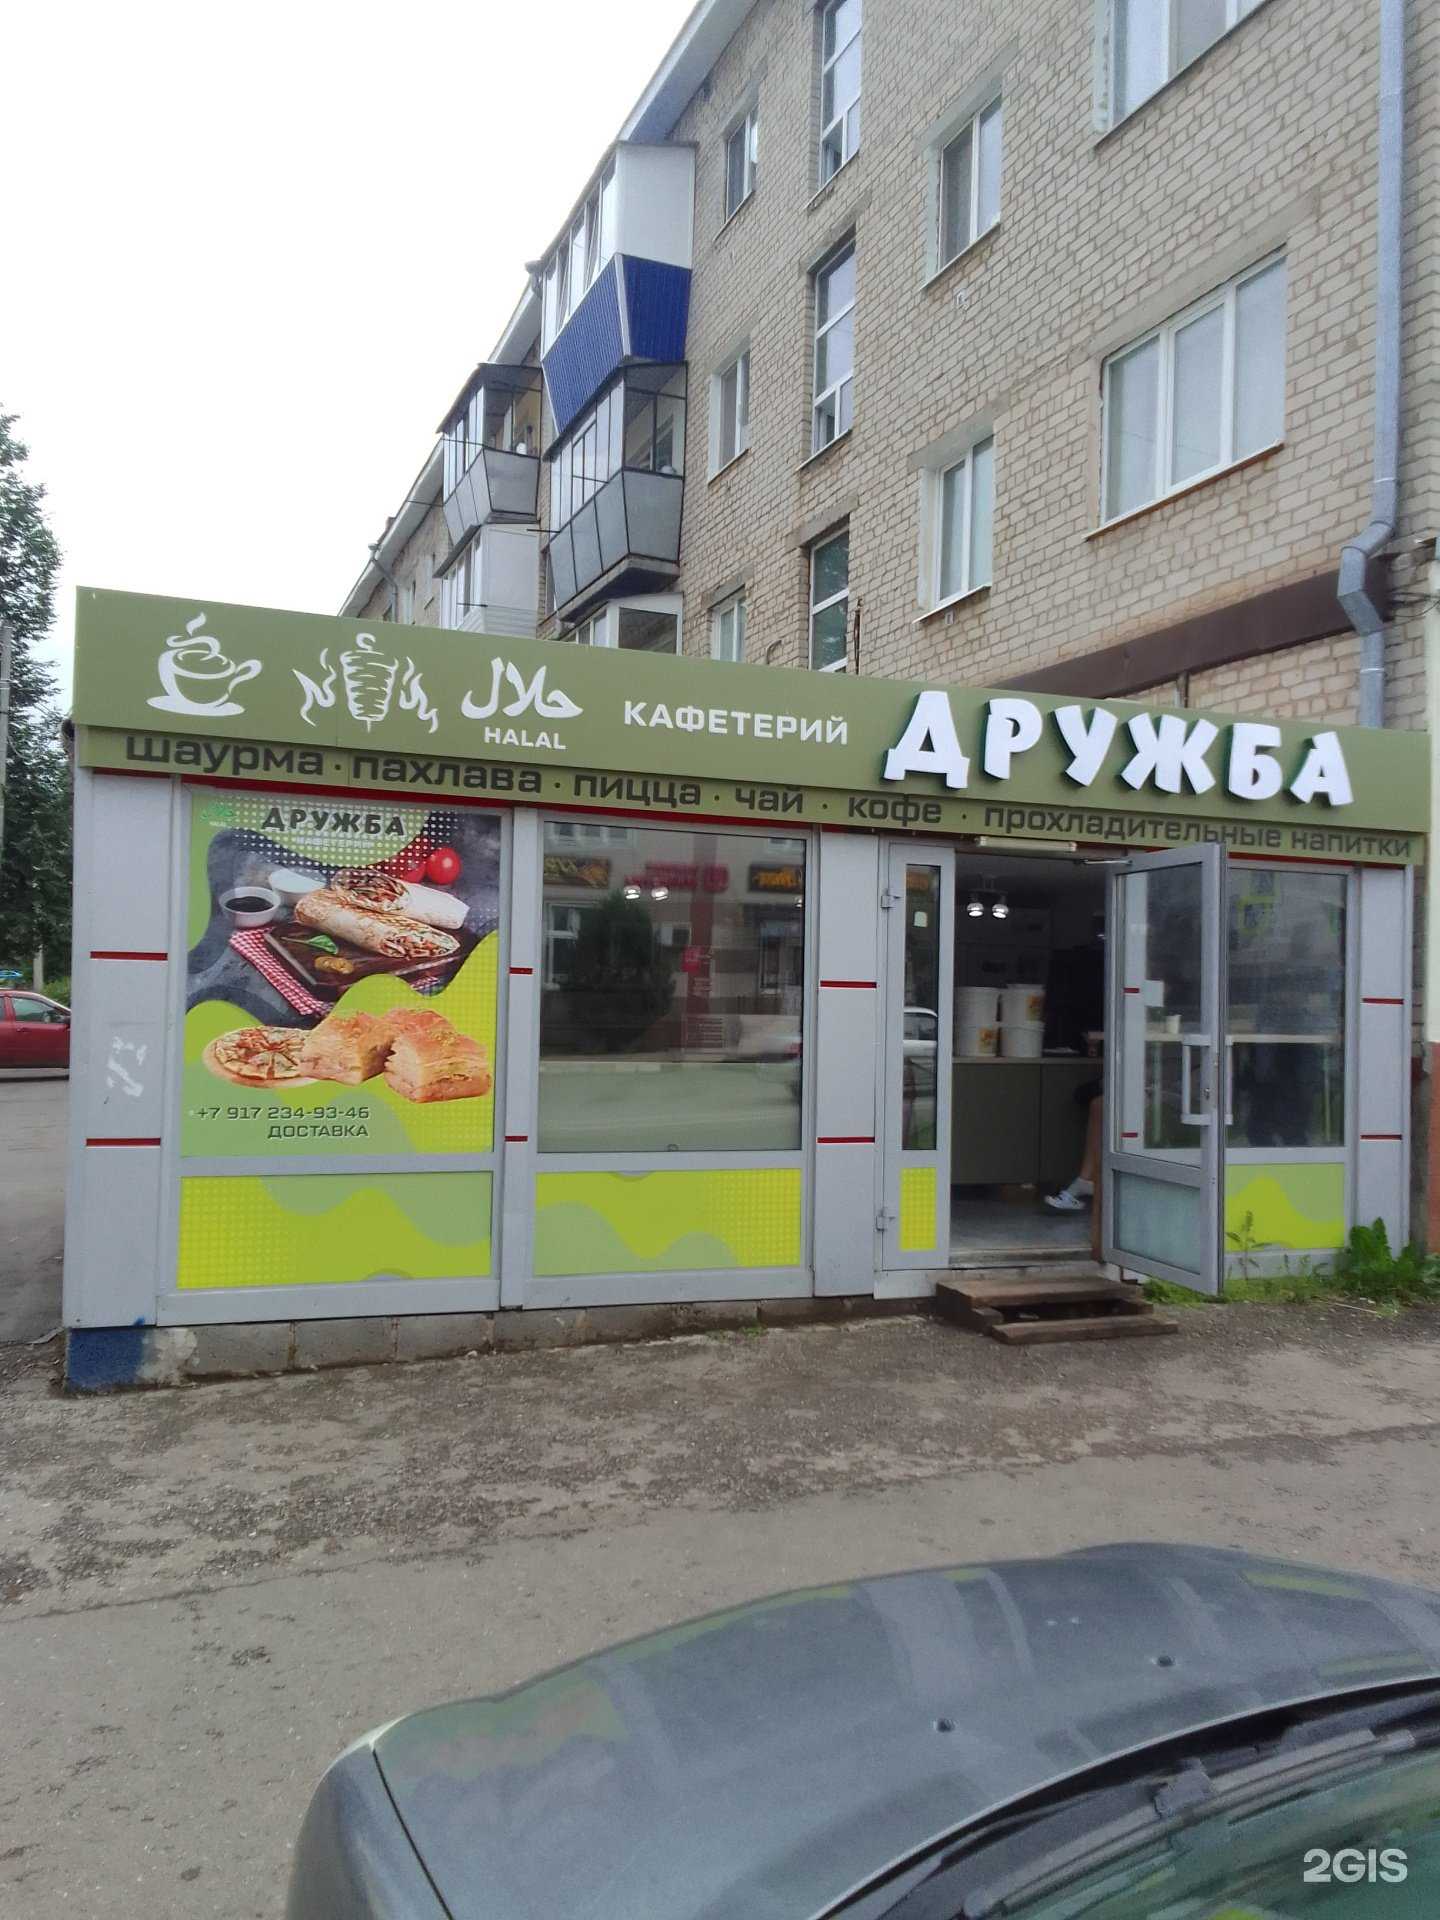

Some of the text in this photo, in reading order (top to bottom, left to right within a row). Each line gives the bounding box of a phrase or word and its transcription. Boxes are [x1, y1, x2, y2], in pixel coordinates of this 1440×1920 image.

[623, 700, 848, 746] КАФЕТЕРИЙ
[483, 726, 567, 751] HALAL
[883, 690, 1354, 807] ДРУЖБА
[126, 735, 1412, 857] шаурма пахлава пицца чай кофе прохладительные напитки
[261, 807, 406, 837] ДРУЖБА
[197, 1107, 369, 1120] +7 917 234-93-46
[267, 1124, 369, 1139] ДОСТАВКА
